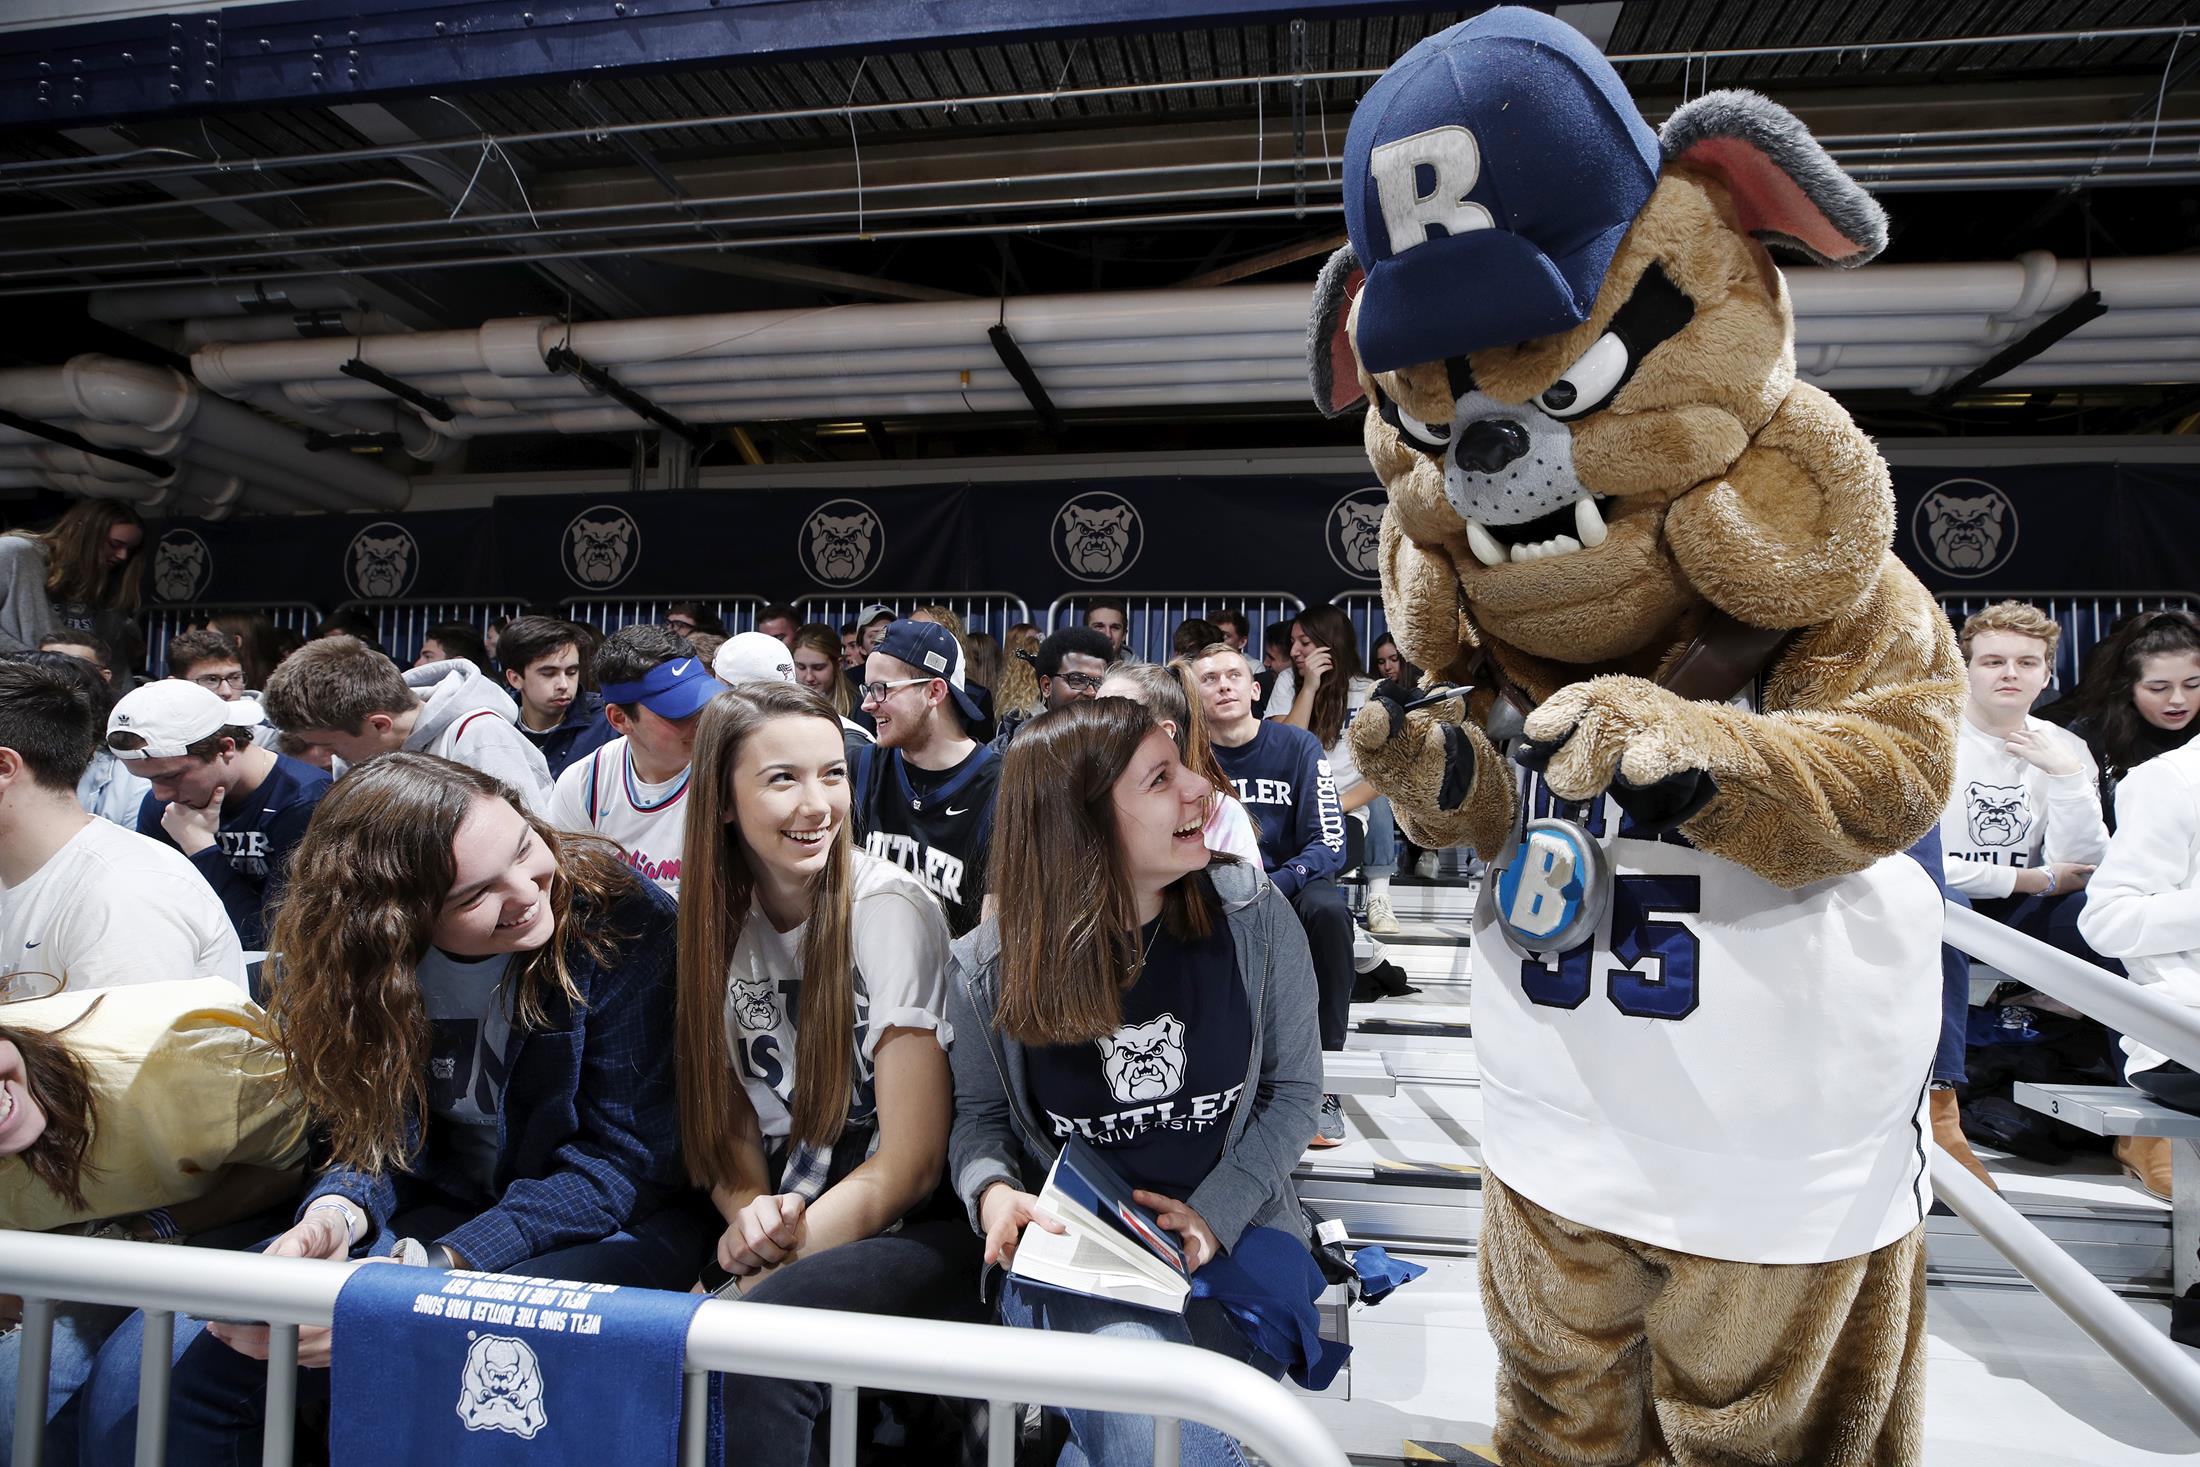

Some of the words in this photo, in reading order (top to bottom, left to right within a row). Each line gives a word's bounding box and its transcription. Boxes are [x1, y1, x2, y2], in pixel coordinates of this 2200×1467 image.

[1509, 831, 1577, 937] B
[2051, 1100, 2060, 1115] 3
[441, 1278, 472, 1296] CRY
[466, 1281, 523, 1302] FIGHTING
[516, 1285, 535, 1303] A
[413, 1293, 447, 1317] SONG
[445, 1298, 472, 1320] WAR
[556, 1290, 593, 1310] WE'LL
[471, 1301, 517, 1326] BUTLER
[514, 1306, 538, 1329] THE
[538, 1309, 568, 1332] SING
[569, 1312, 602, 1335] WE'LL
